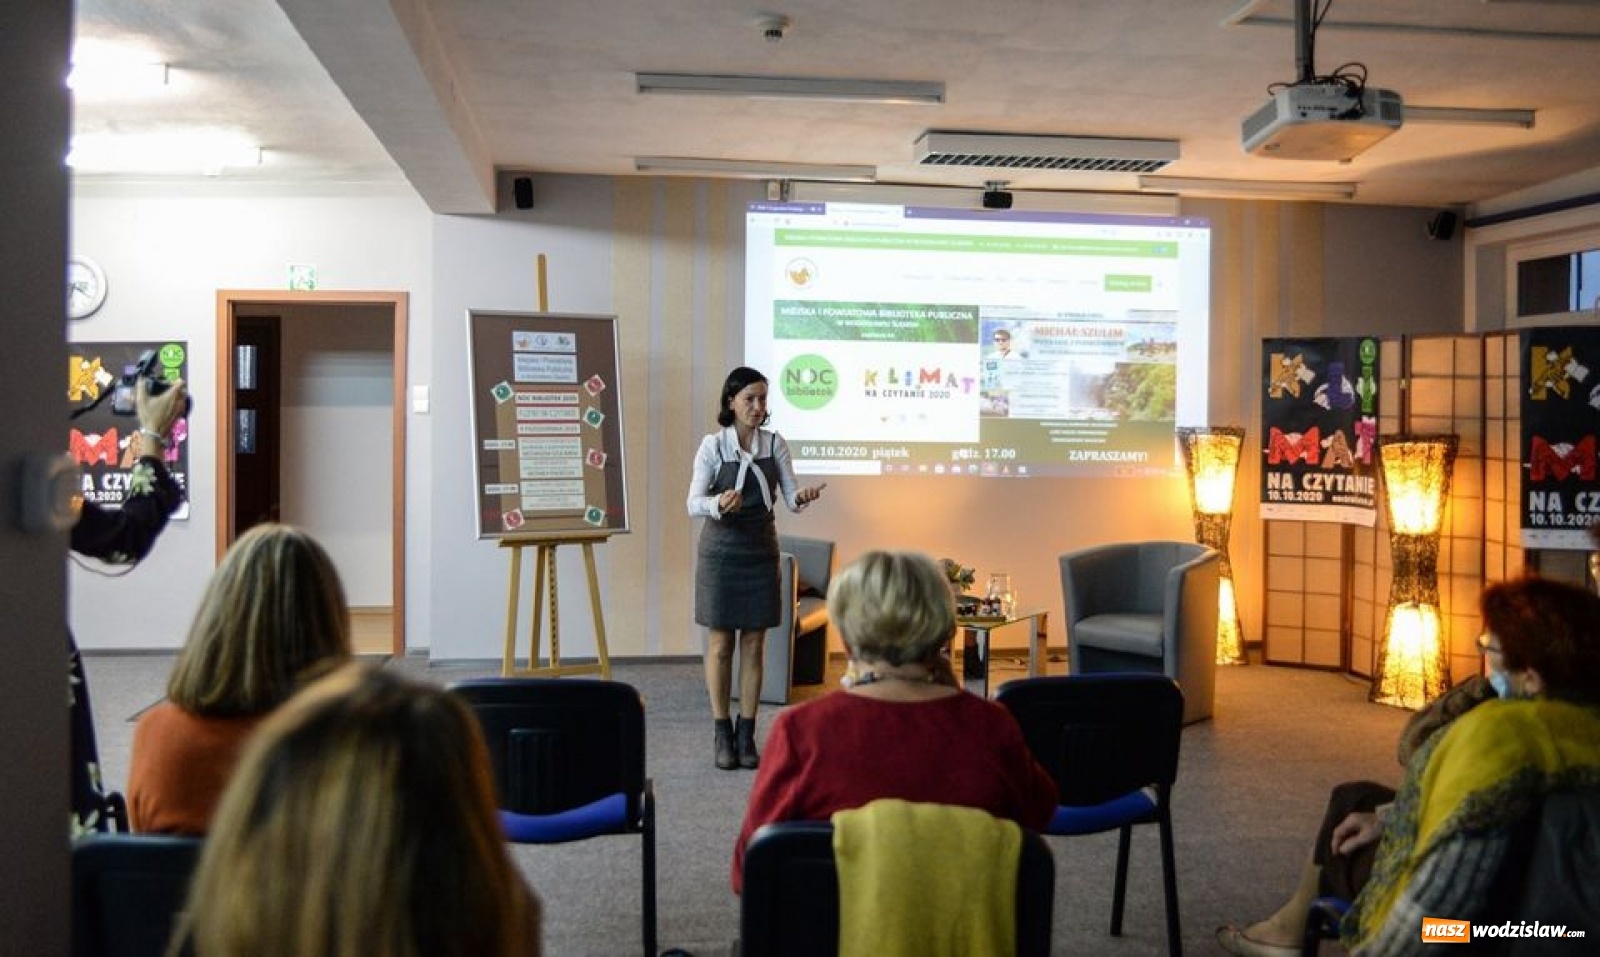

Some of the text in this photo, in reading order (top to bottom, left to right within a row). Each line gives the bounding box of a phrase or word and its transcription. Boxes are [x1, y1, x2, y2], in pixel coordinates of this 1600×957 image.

[786, 368, 833, 384] NOC
[864, 367, 975, 394] KLIMAT
[786, 386, 833, 396] bibliotek
[864, 389, 951, 399] NA CZYTANIE 2020
[801, 445, 868, 457] 09.10.2020
[872, 446, 910, 459] piątek
[985, 448, 1016, 459] 17.00
[1069, 450, 1148, 462] ZAPRASZAMY!
[1267, 472, 1375, 496] NA CZYTANIE
[1267, 490, 1323, 502] 10.10.2020
[1529, 491, 1562, 513] NA
